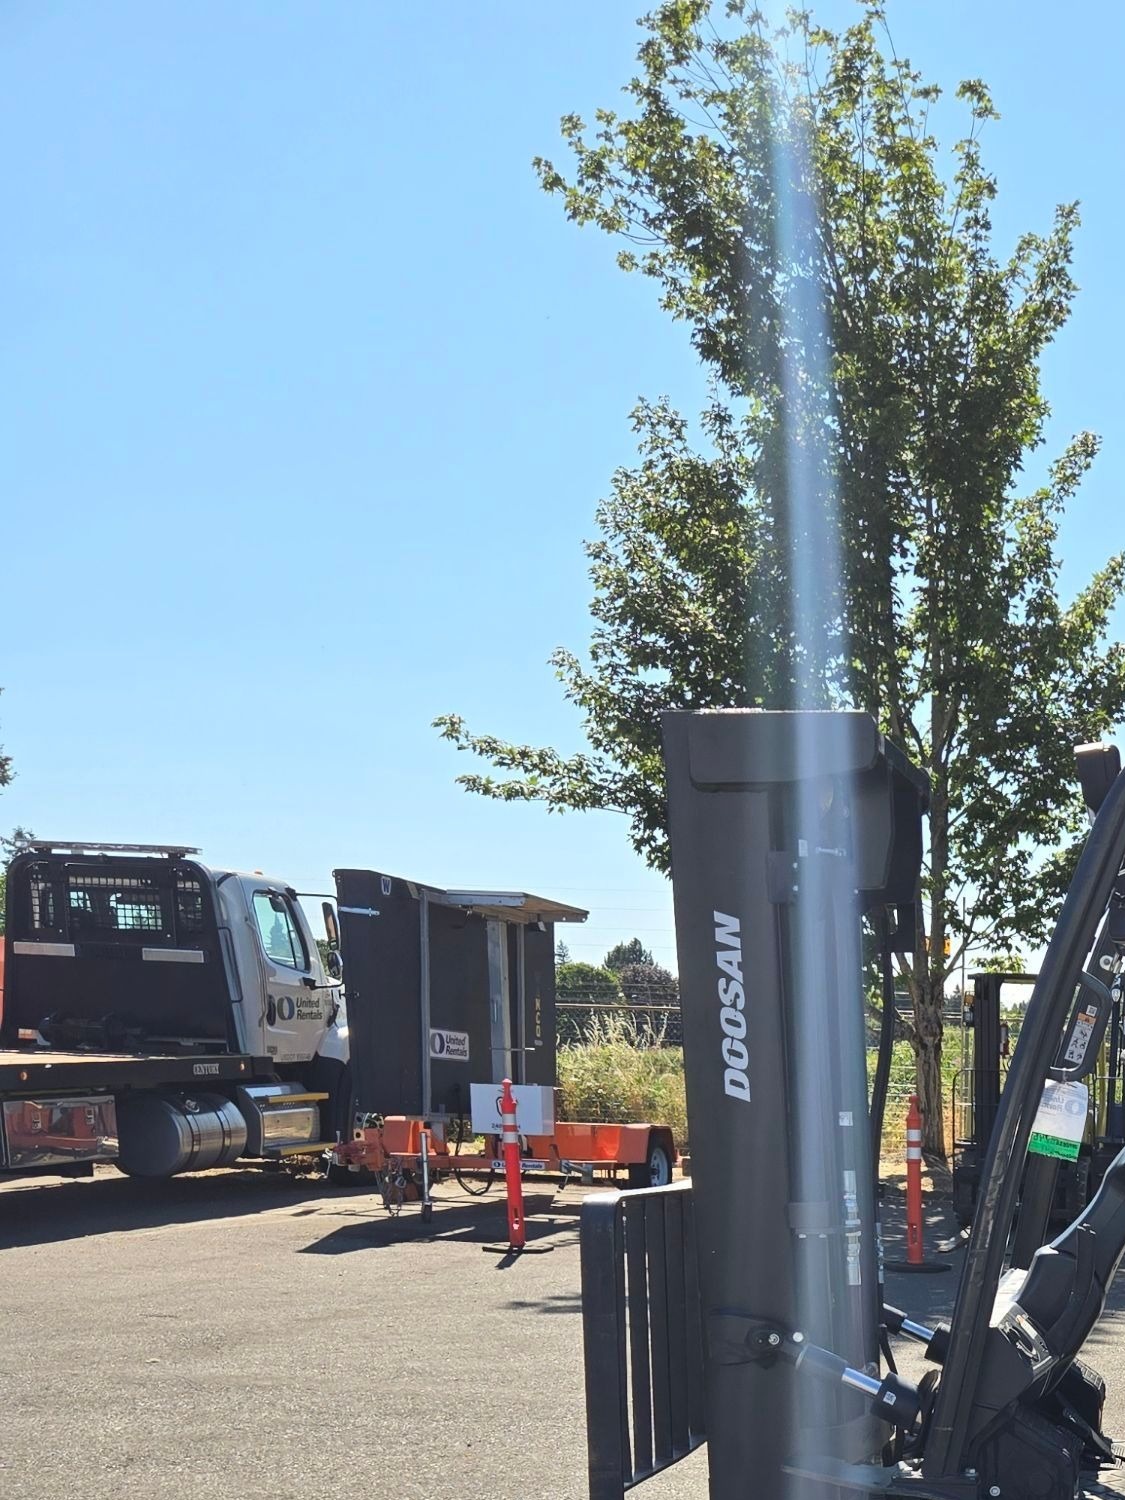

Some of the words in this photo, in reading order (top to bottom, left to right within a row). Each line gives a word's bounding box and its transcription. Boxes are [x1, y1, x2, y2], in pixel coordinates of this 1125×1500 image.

[296, 996, 320, 1009] United
[713, 910, 751, 1102] DOOSAN
[296, 1009, 323, 1020] Rentals
[445, 1034, 467, 1046] United
[445, 1045, 468, 1057] Rentals
[193, 1063, 220, 1075] CENTURY
[521, 1162, 543, 1170] Rentals
